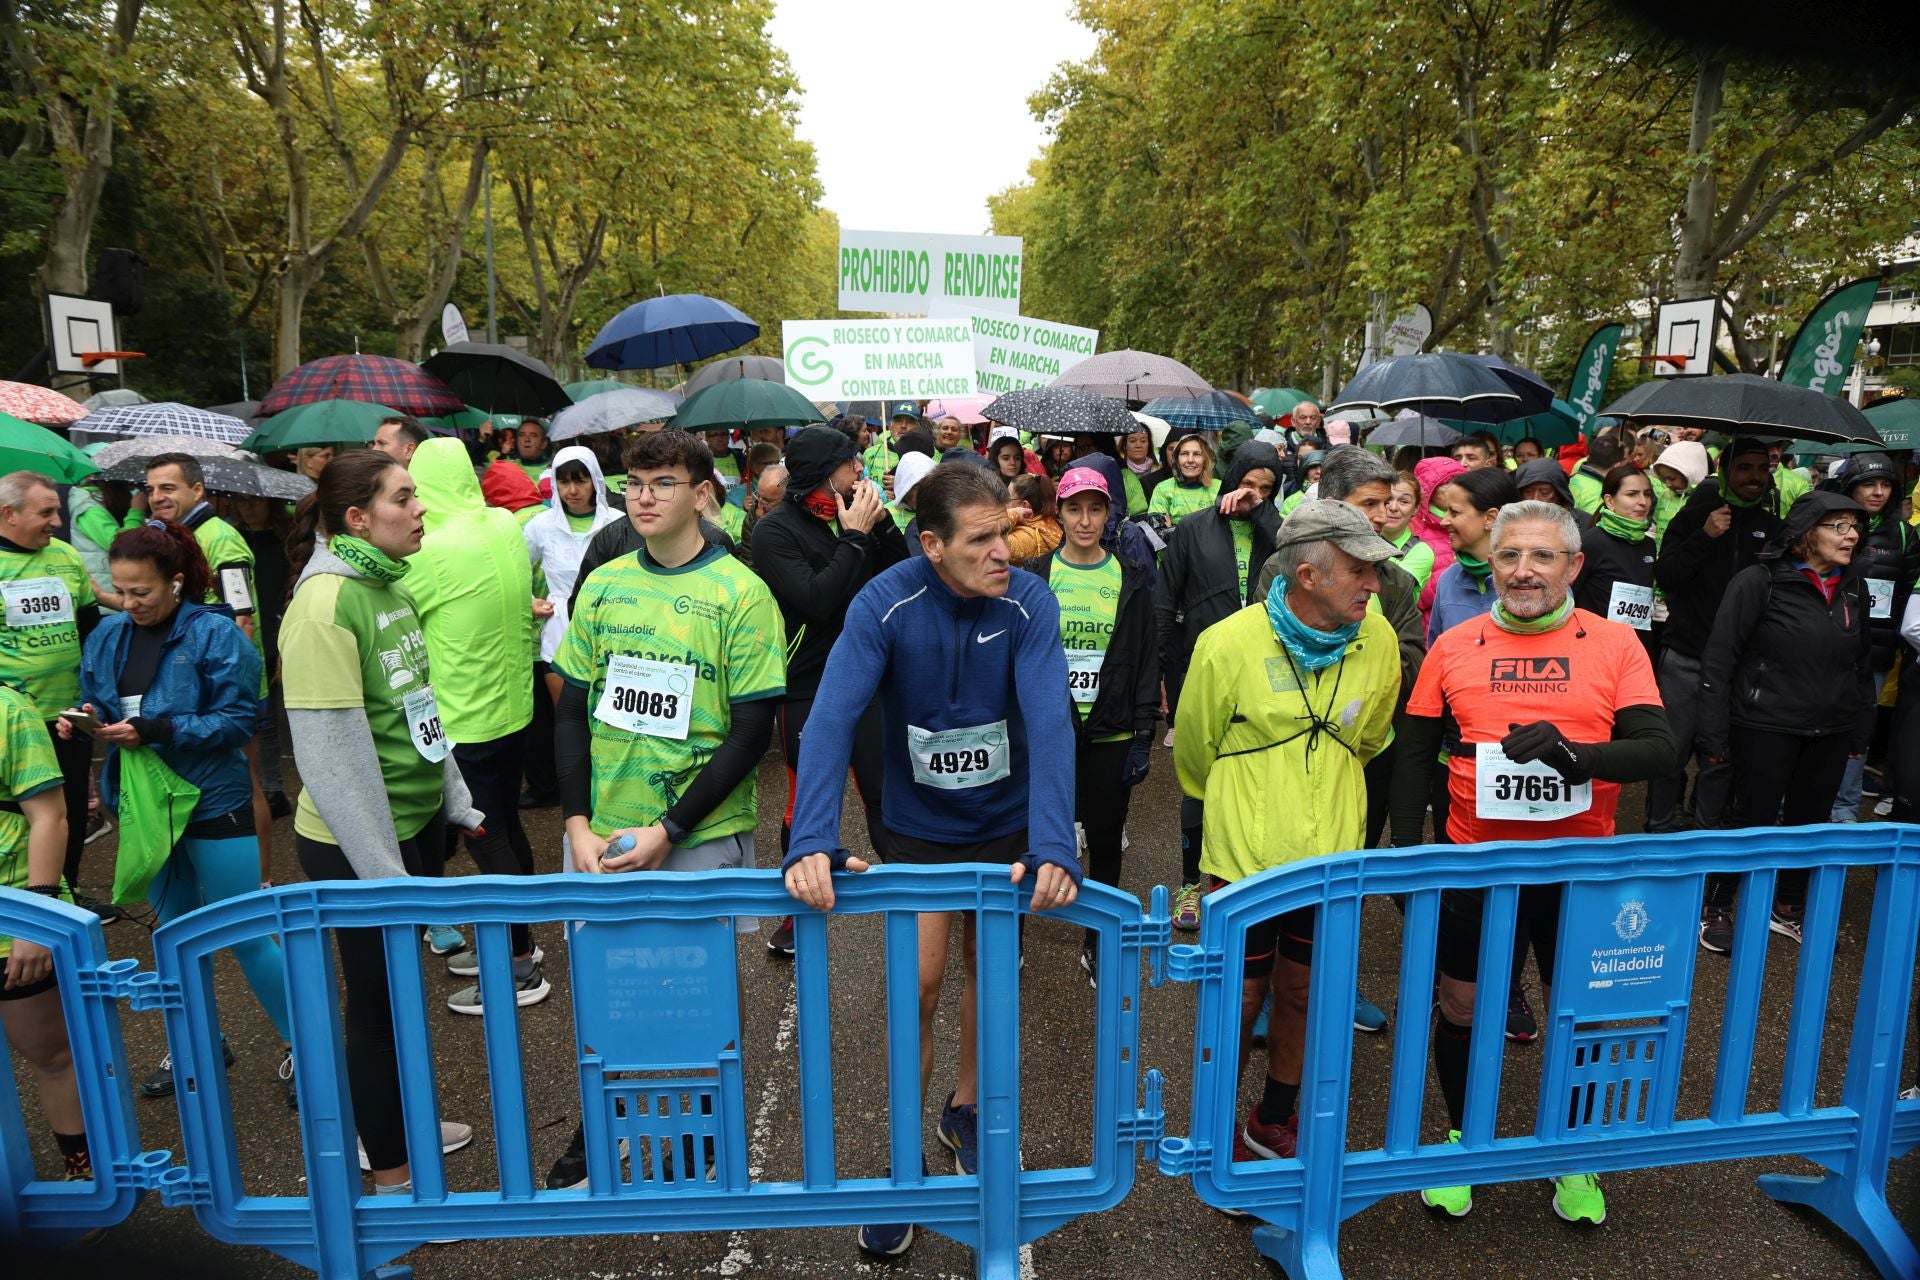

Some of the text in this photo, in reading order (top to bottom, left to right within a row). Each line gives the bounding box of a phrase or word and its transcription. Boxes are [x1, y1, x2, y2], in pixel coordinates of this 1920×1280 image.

[841, 247, 1019, 299] PROHIBIDO RENDIRSE
[833, 326, 971, 345] RIOSECO Y COMARCA
[1023, 326, 1032, 342] Y
[1033, 328, 1093, 355] COMARCA
[865, 352, 943, 370] EN MARCHA
[990, 347, 1060, 376] EN MARCHA
[1807, 311, 1850, 393] nglés
[841, 373, 969, 397] CONTRA EL CÁNCER
[21, 596, 60, 614] 3389
[1617, 601, 1649, 619] 34299
[27, 630, 79, 648] cánce
[607, 624, 656, 636] Valladolid
[1494, 660, 1566, 679] FILA
[1490, 682, 1567, 693] RUNNING
[613, 686, 678, 719] 30083
[929, 749, 989, 774] 4929
[1495, 774, 1571, 802] 37651
[607, 946, 708, 971] FMD
[1592, 943, 1665, 959] Ayuntamiento de
[1591, 954, 1664, 974] Valladolid
[1588, 979, 1613, 989] FMD
